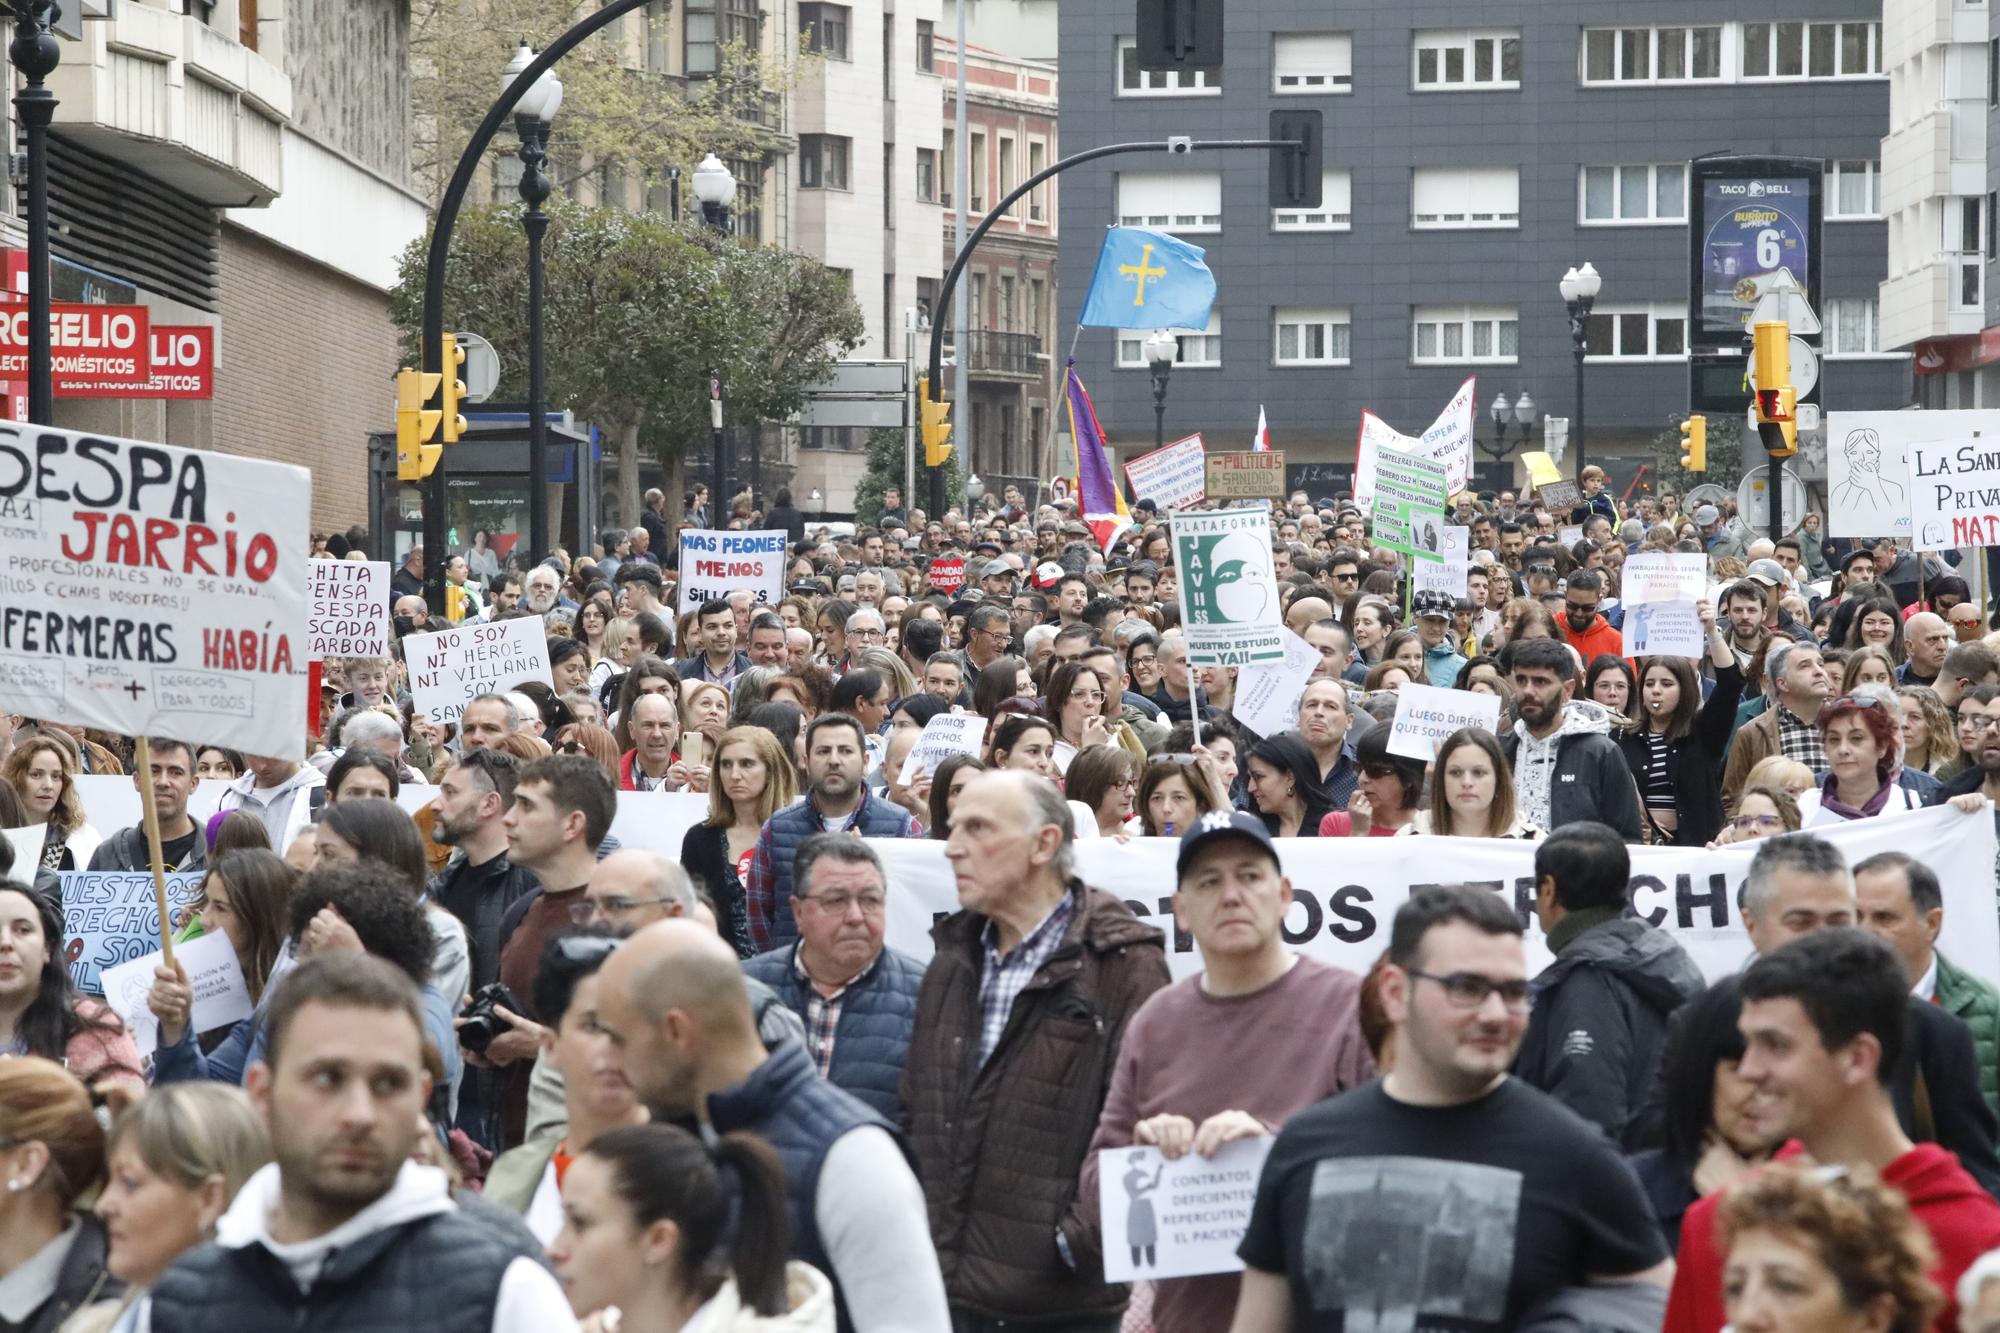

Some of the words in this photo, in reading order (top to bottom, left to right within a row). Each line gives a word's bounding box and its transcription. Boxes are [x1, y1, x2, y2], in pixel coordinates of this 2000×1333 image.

[1720, 185, 1746, 194] TACO
[1766, 185, 1791, 194] BELL
[1734, 211, 1778, 222] BURRITO
[1378, 451, 1412, 467] CARTELERAS
[1222, 470, 1275, 486] SANIDAD
[1376, 467, 1399, 481] FEBRERO
[1420, 480, 1443, 493] TRABAJO
[1375, 483, 1396, 496] AGOSTO
[1380, 502, 1397, 511] QUIEN
[1175, 516, 1267, 533] PLATAFORMA
[1376, 513, 1402, 527] GESTIONA
[722, 535, 785, 554] PEONES
[696, 560, 763, 577] MENOS
[162, 575, 183, 589] NO
[197, 578, 216, 593] SE
[314, 601, 382, 618] SESPA
[309, 619, 376, 637] SCADA
[437, 634, 460, 650] NO
[474, 625, 508, 644] SOY
[1189, 641, 1231, 650] NUESTRO
[1235, 637, 1281, 649] ESTUDIO
[427, 652, 447, 669] NI
[418, 671, 440, 688] NI
[454, 656, 540, 682] VILLANA
[464, 680, 497, 699] SOY
[1409, 708, 1445, 722] LUEGO
[1395, 722, 1420, 735] QUE
[64, 937, 84, 962] O
[1171, 1170, 1252, 1188] CONTRATOS
[1163, 1209, 1247, 1225] REPERCUTEN
[1174, 1232, 1188, 1244] EL
